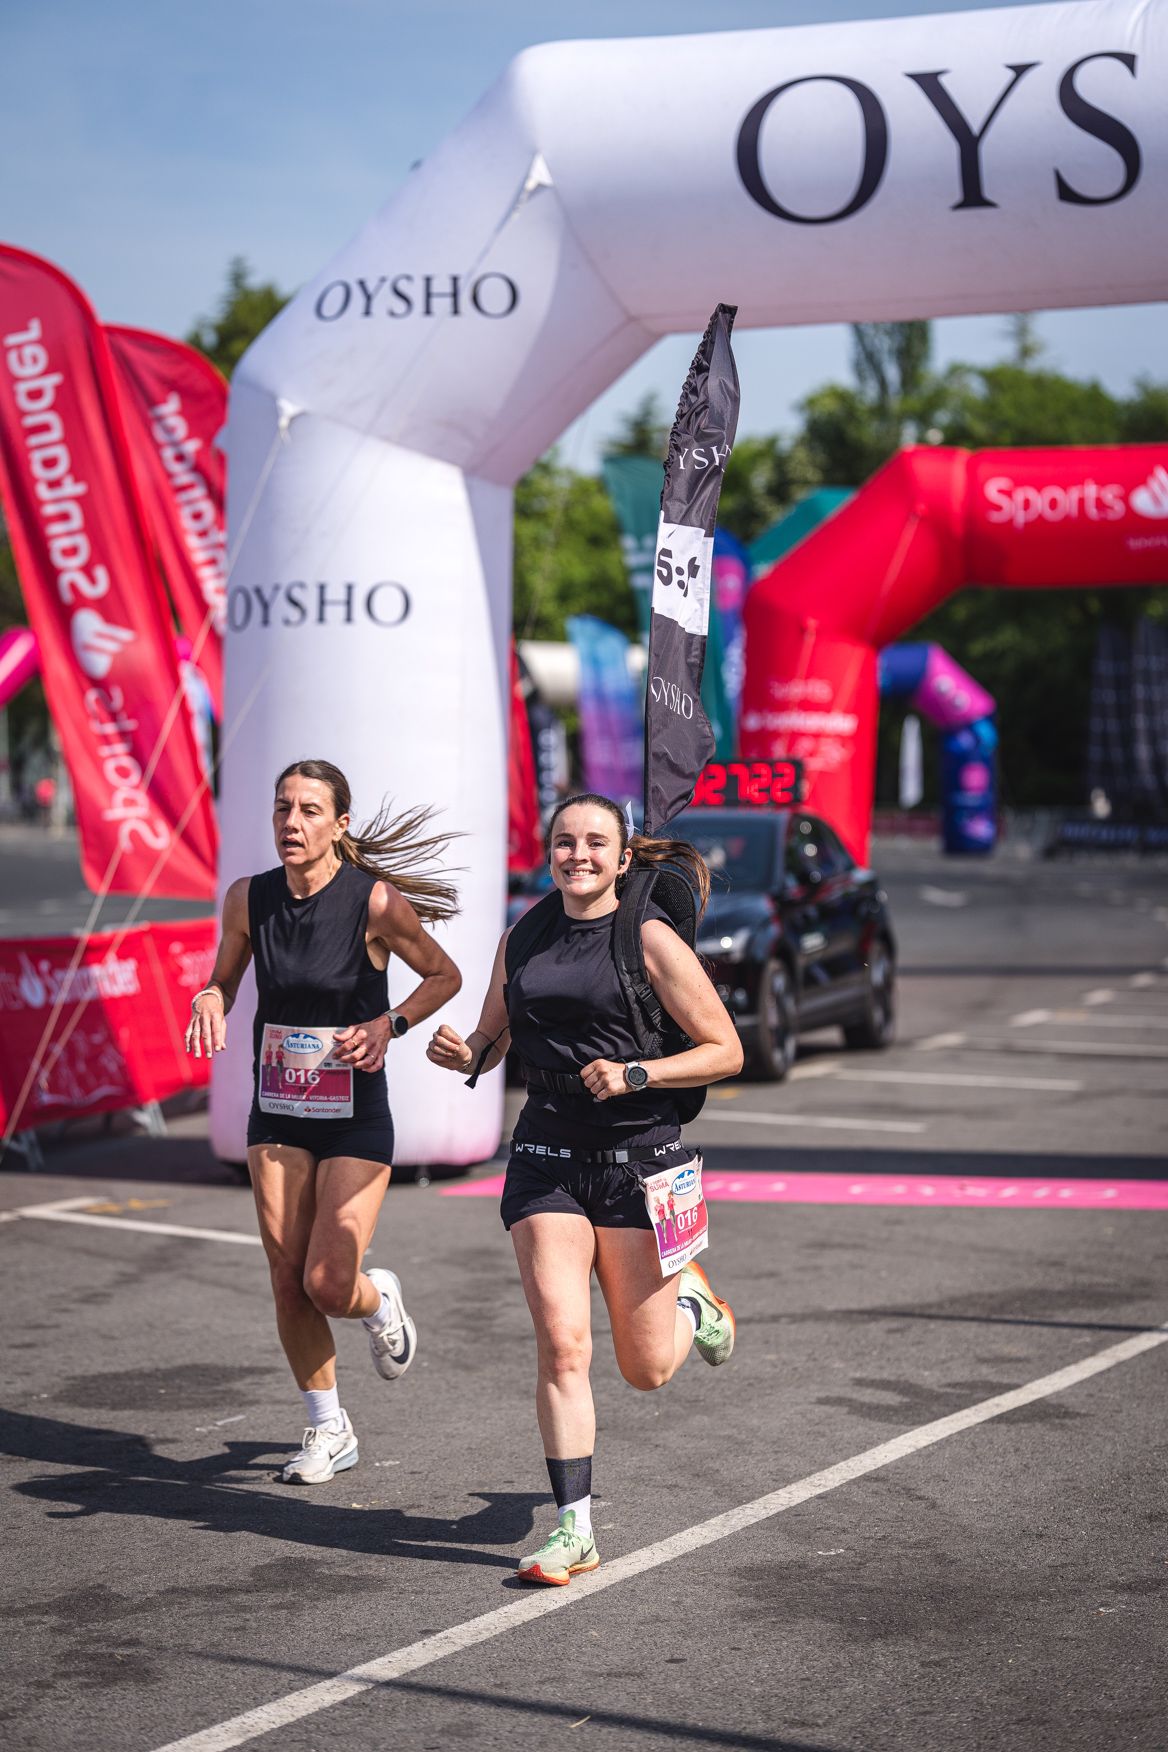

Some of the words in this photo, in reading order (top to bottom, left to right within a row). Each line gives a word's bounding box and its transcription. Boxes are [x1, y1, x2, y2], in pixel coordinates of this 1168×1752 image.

[314, 271, 520, 322] OYSHO
[983, 476, 1126, 530] Sports
[227, 581, 412, 632] OYSHO
[286, 1040, 320, 1049] ASTURIANA
[284, 1068, 320, 1085] 016
[268, 1101, 295, 1112] OYSHO
[515, 1143, 572, 1159] WRELS
[677, 1206, 698, 1230] 016
